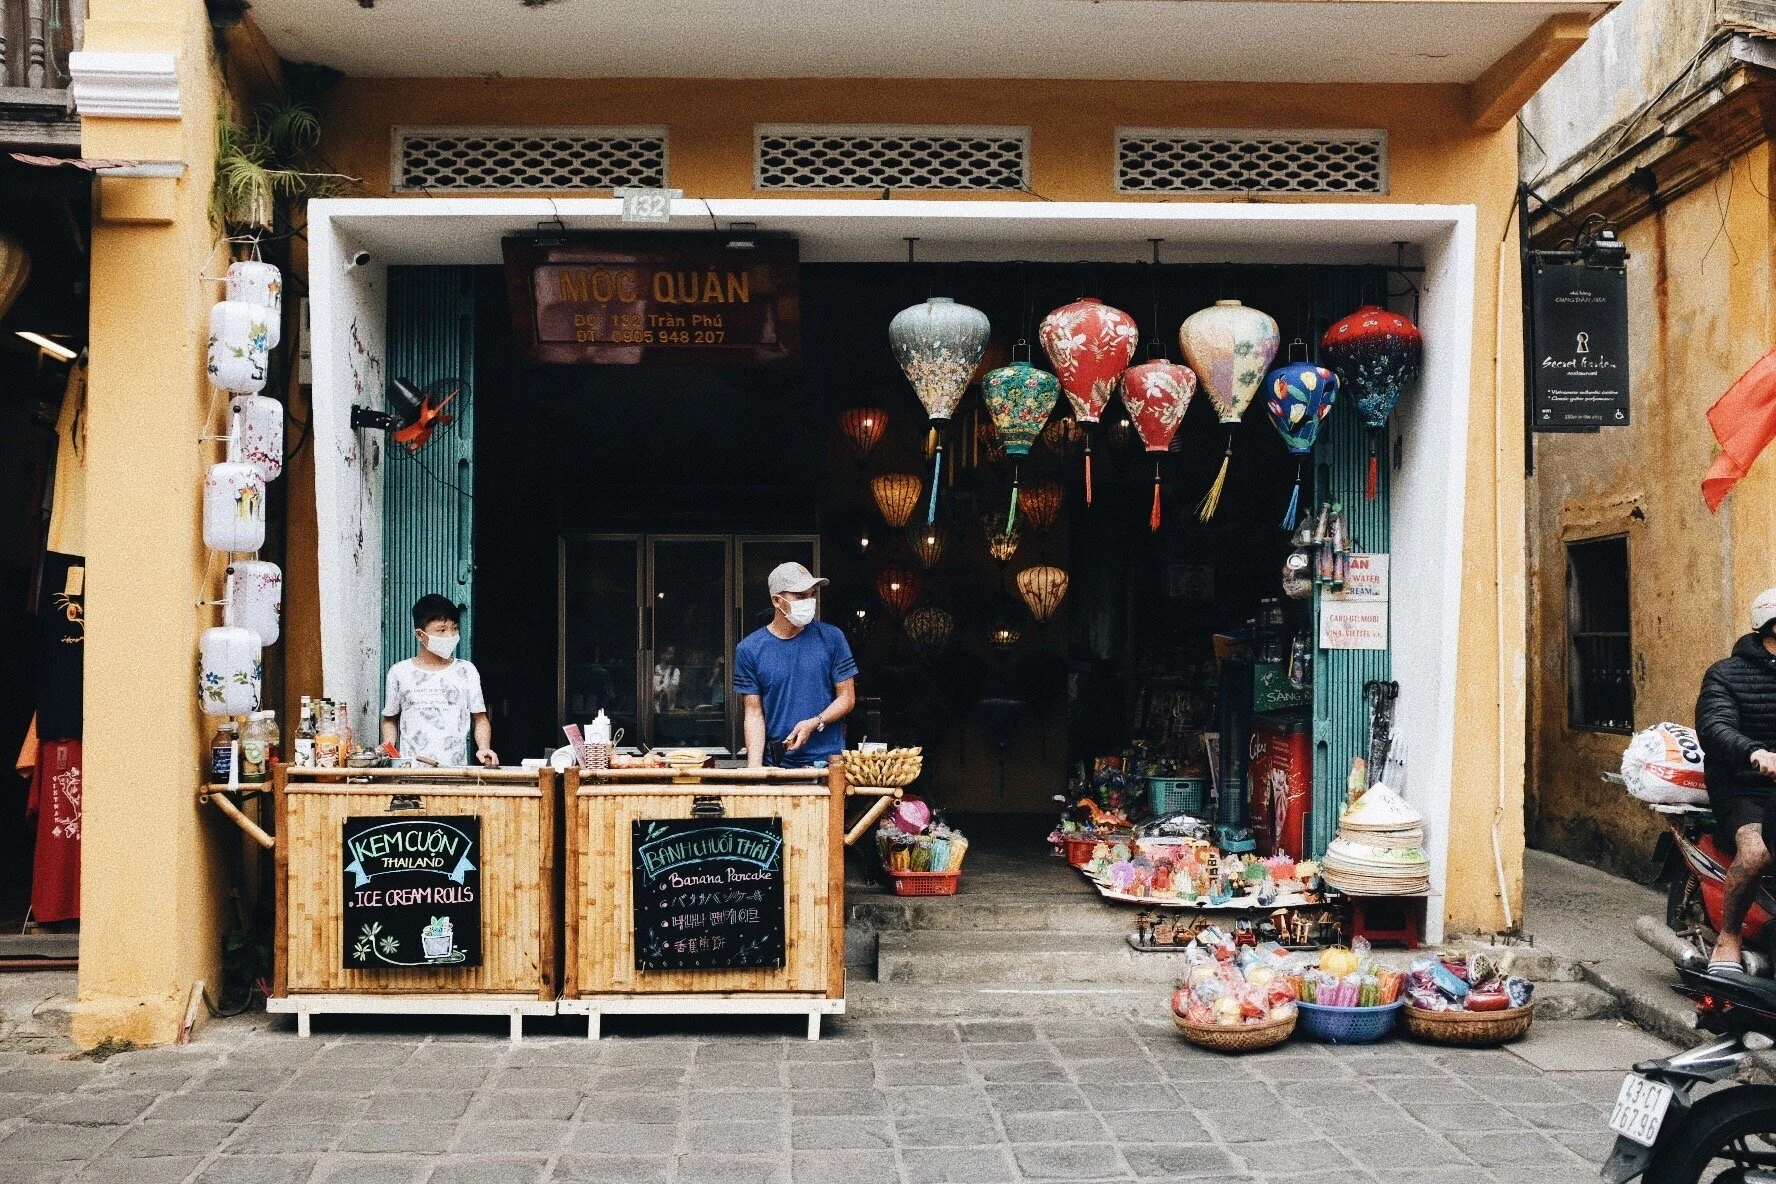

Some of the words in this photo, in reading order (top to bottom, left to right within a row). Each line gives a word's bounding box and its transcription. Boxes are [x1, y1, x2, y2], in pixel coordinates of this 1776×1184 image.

[630, 195, 665, 216] 132
[653, 265, 749, 304] QUÁN
[649, 312, 685, 328] Trần
[692, 313, 723, 328] Phú
[659, 331, 689, 344] 948
[694, 331, 725, 344] 207
[1542, 356, 1577, 369] Secret
[1352, 574, 1380, 584] WATER
[355, 831, 403, 862] KEM
[405, 828, 459, 857] CUỘN
[381, 857, 445, 869] THAILAND
[669, 872, 724, 888] Banana
[725, 867, 773, 883] Pancake
[355, 891, 383, 907] ICE
[385, 887, 431, 907] CREAM
[434, 886, 474, 904] ROLLS
